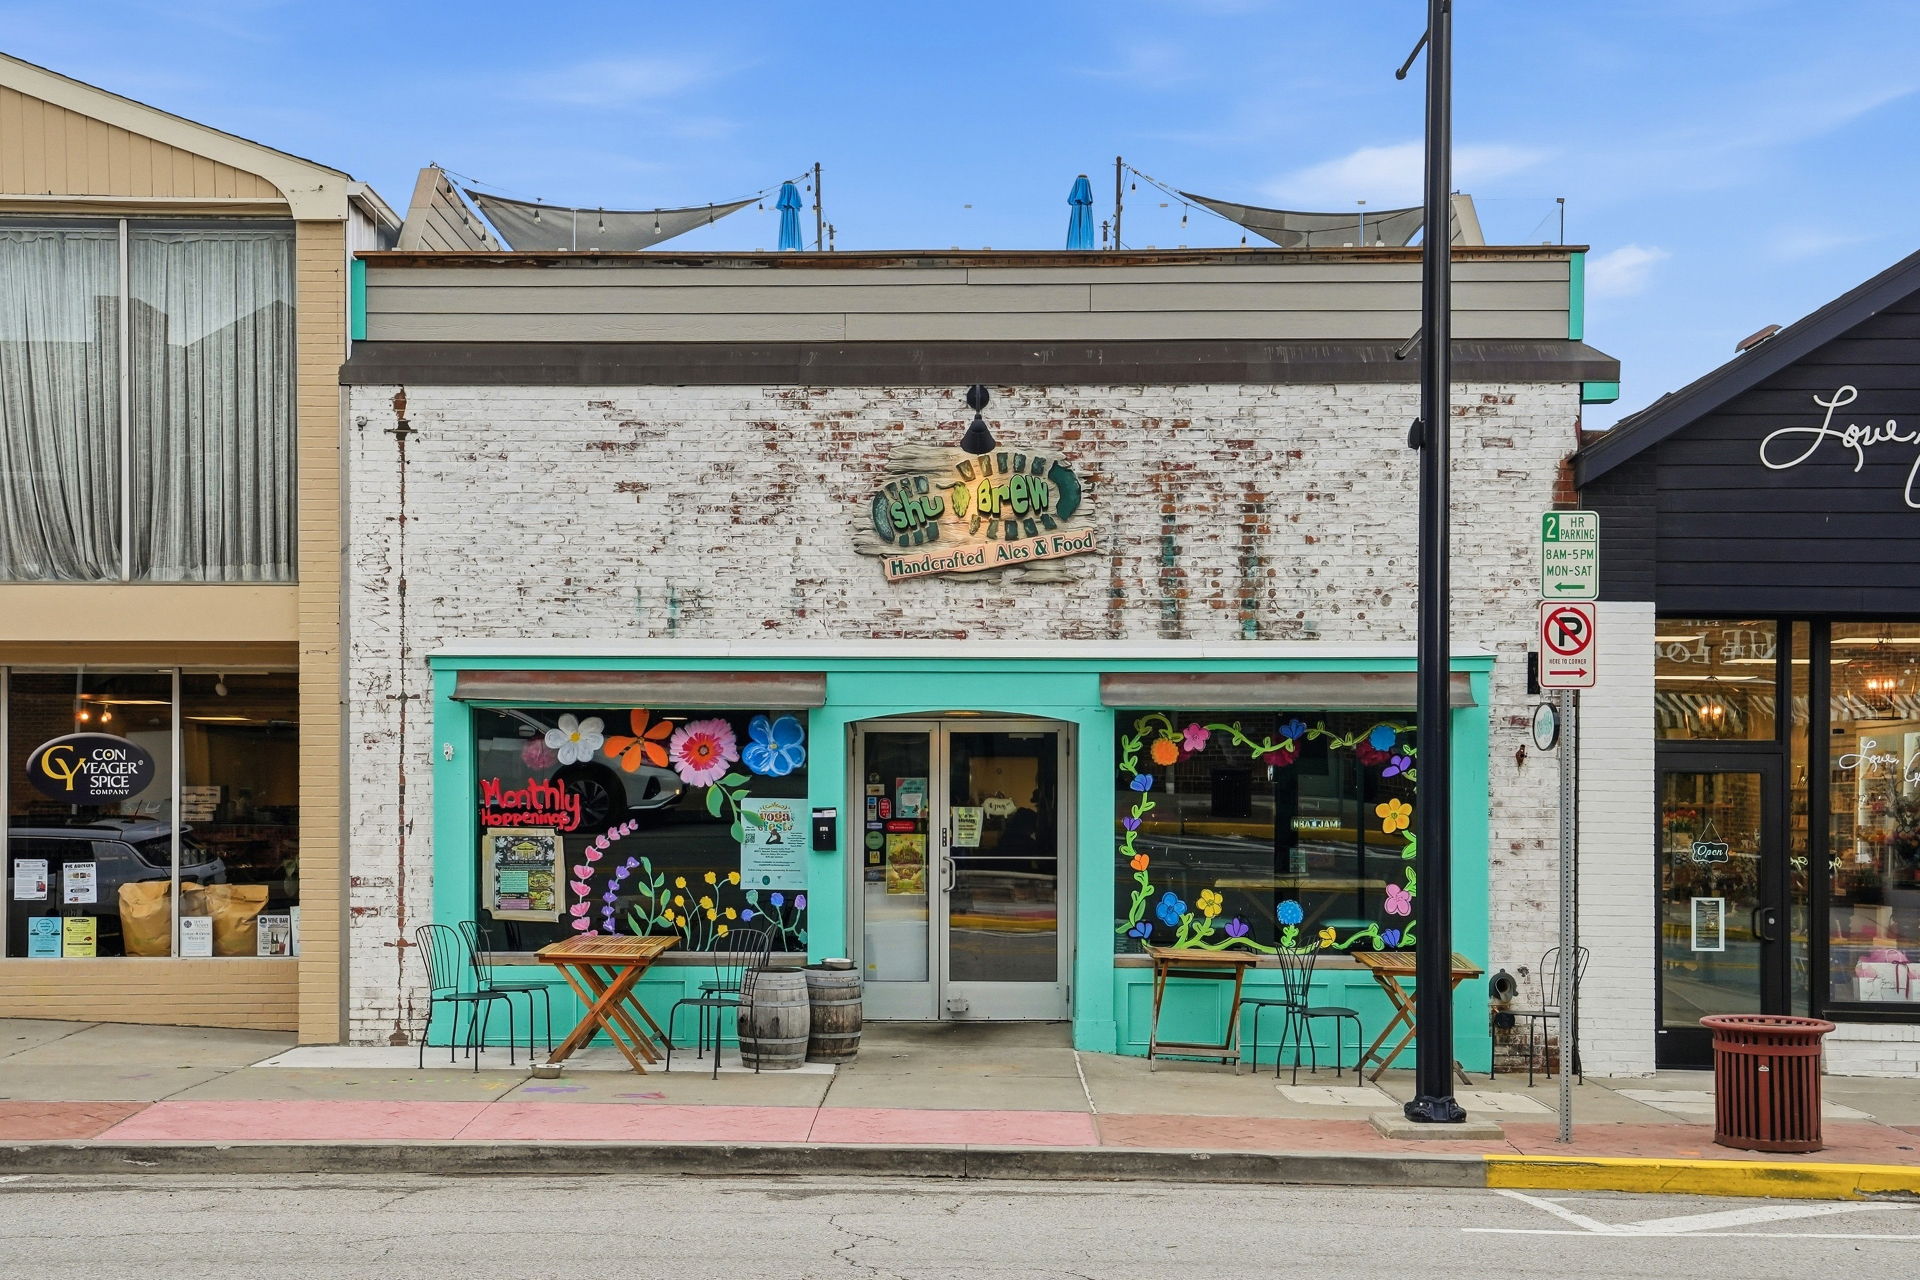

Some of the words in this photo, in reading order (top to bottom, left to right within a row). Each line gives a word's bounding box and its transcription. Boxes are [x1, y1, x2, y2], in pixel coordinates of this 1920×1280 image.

[1546, 516, 1556, 539] 2
[1570, 517, 1585, 528] HR
[1560, 529, 1595, 540] PARKING
[891, 548, 985, 576] Handcrafted
[996, 545, 1029, 563] Ales
[1034, 540, 1048, 556] &
[1053, 533, 1093, 553] Food
[1546, 565, 1593, 577] MON-SAT
[92, 748, 126, 761] CON
[81, 762, 139, 774] YEAGER
[89, 775, 130, 788] SPICE
[90, 788, 130, 796] COMPANY
[480, 777, 581, 832] Monthly
[1697, 845, 1724, 859] Open
